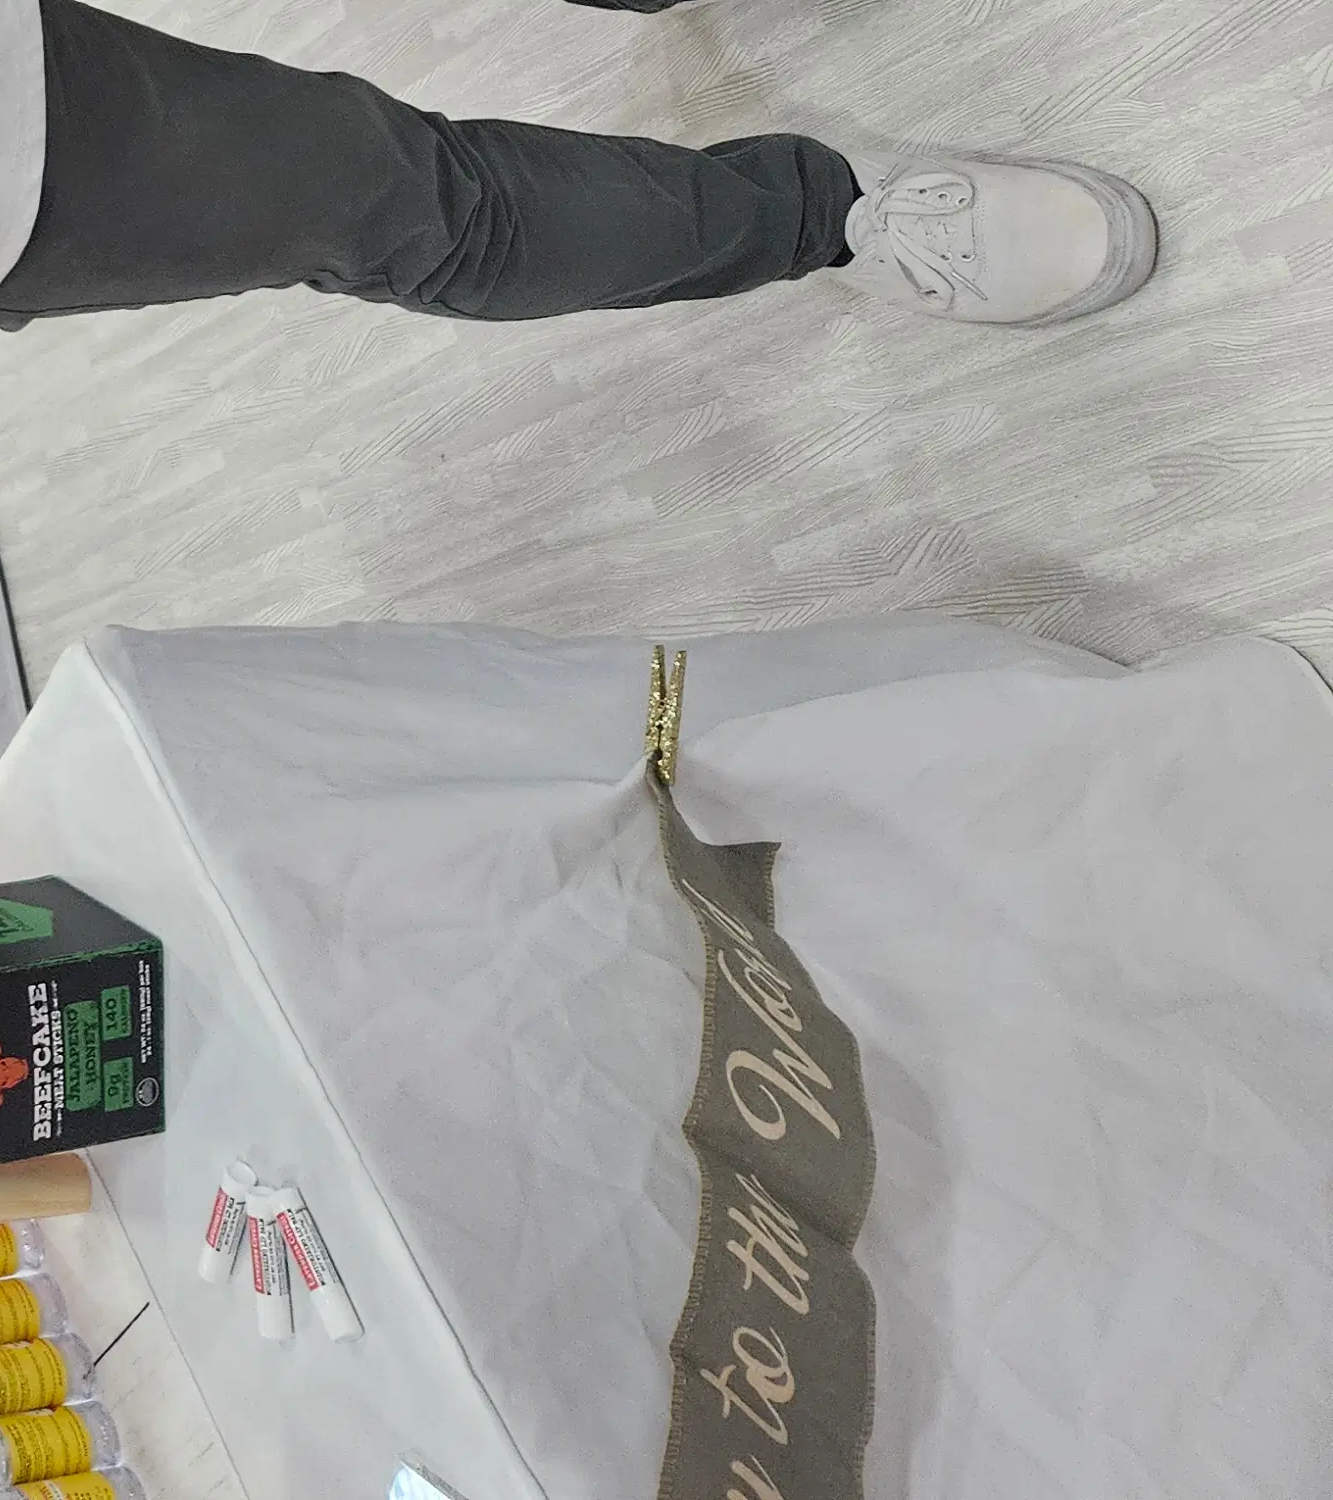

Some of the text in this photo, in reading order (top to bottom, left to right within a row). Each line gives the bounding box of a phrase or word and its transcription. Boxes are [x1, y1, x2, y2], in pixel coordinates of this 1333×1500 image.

[28, 982, 53, 1141] BEEFCAKE
[51, 1010, 65, 1109] MEAT STICKS
[84, 1021, 97, 1085] HONEY
[105, 997, 118, 1032] 140
[699, 1325, 796, 1444] to
